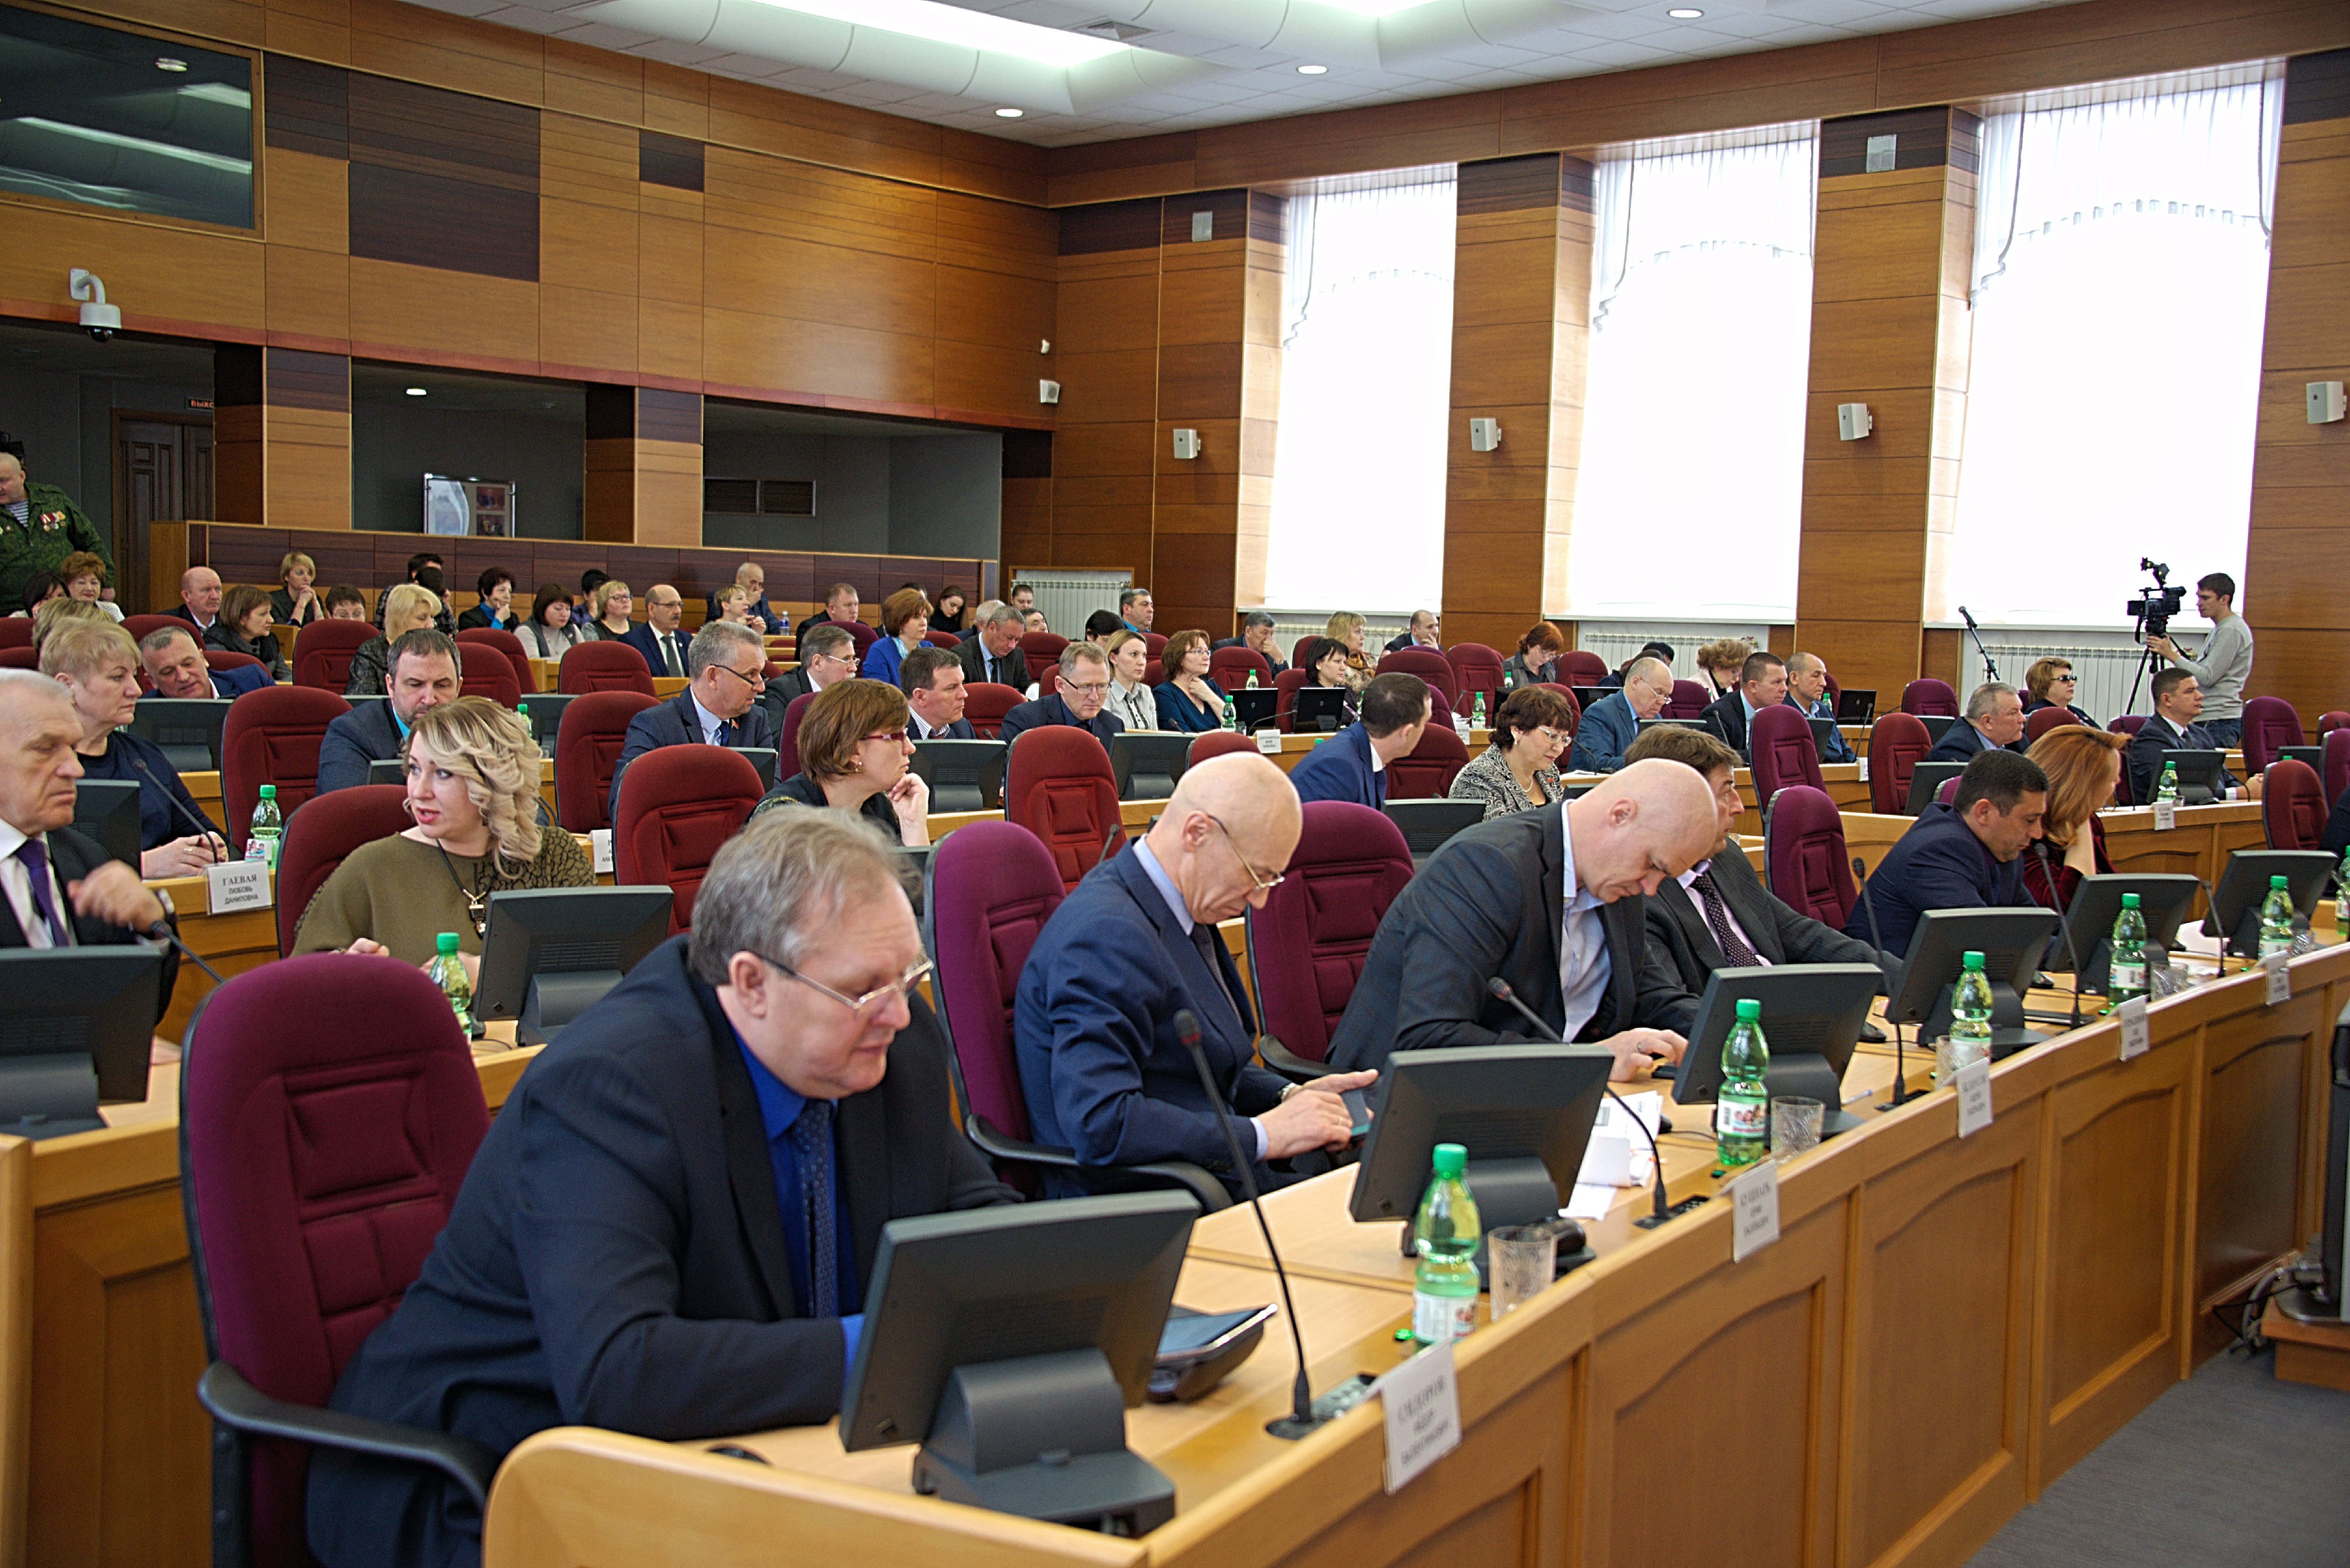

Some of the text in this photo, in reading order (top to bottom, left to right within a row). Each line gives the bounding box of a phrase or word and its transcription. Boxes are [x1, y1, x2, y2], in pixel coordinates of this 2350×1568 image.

[191, 400, 214, 409] ВЫХО
[223, 874, 257, 886] ГАЕВАЯ
[229, 885, 253, 895] ЛЮБОВЬ
[225, 893, 258, 904] ДАНИЛОВНА
